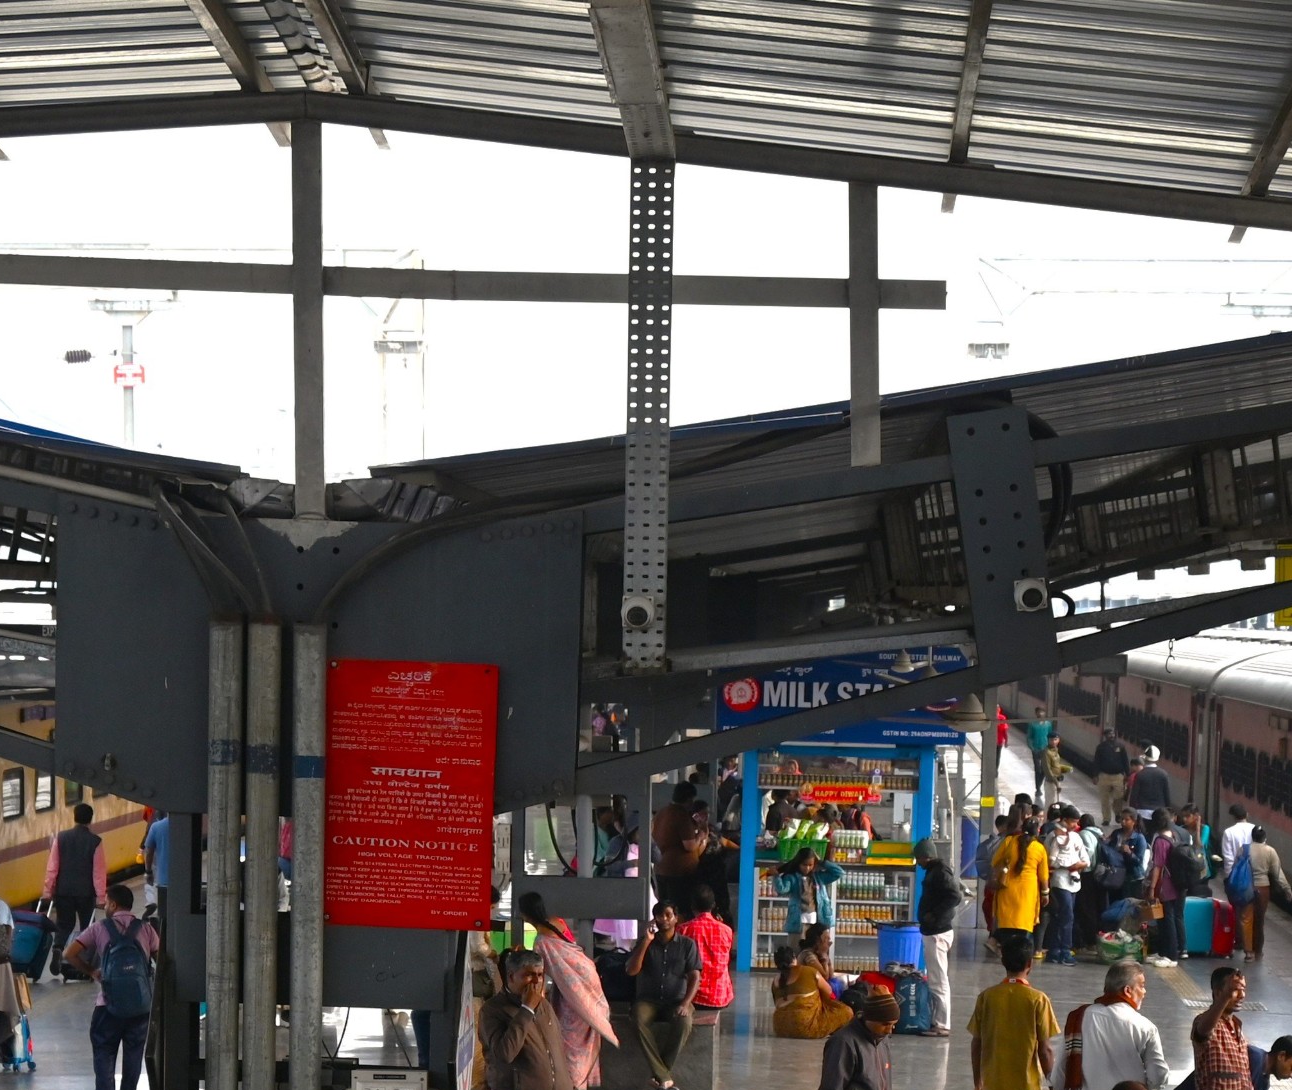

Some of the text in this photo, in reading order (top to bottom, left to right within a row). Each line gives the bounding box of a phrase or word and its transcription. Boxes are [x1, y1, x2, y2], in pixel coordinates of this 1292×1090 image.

[763, 680, 830, 709] MILK
[370, 766, 443, 779] सावधान
[332, 835, 479, 852] CAUTION NOTICE
